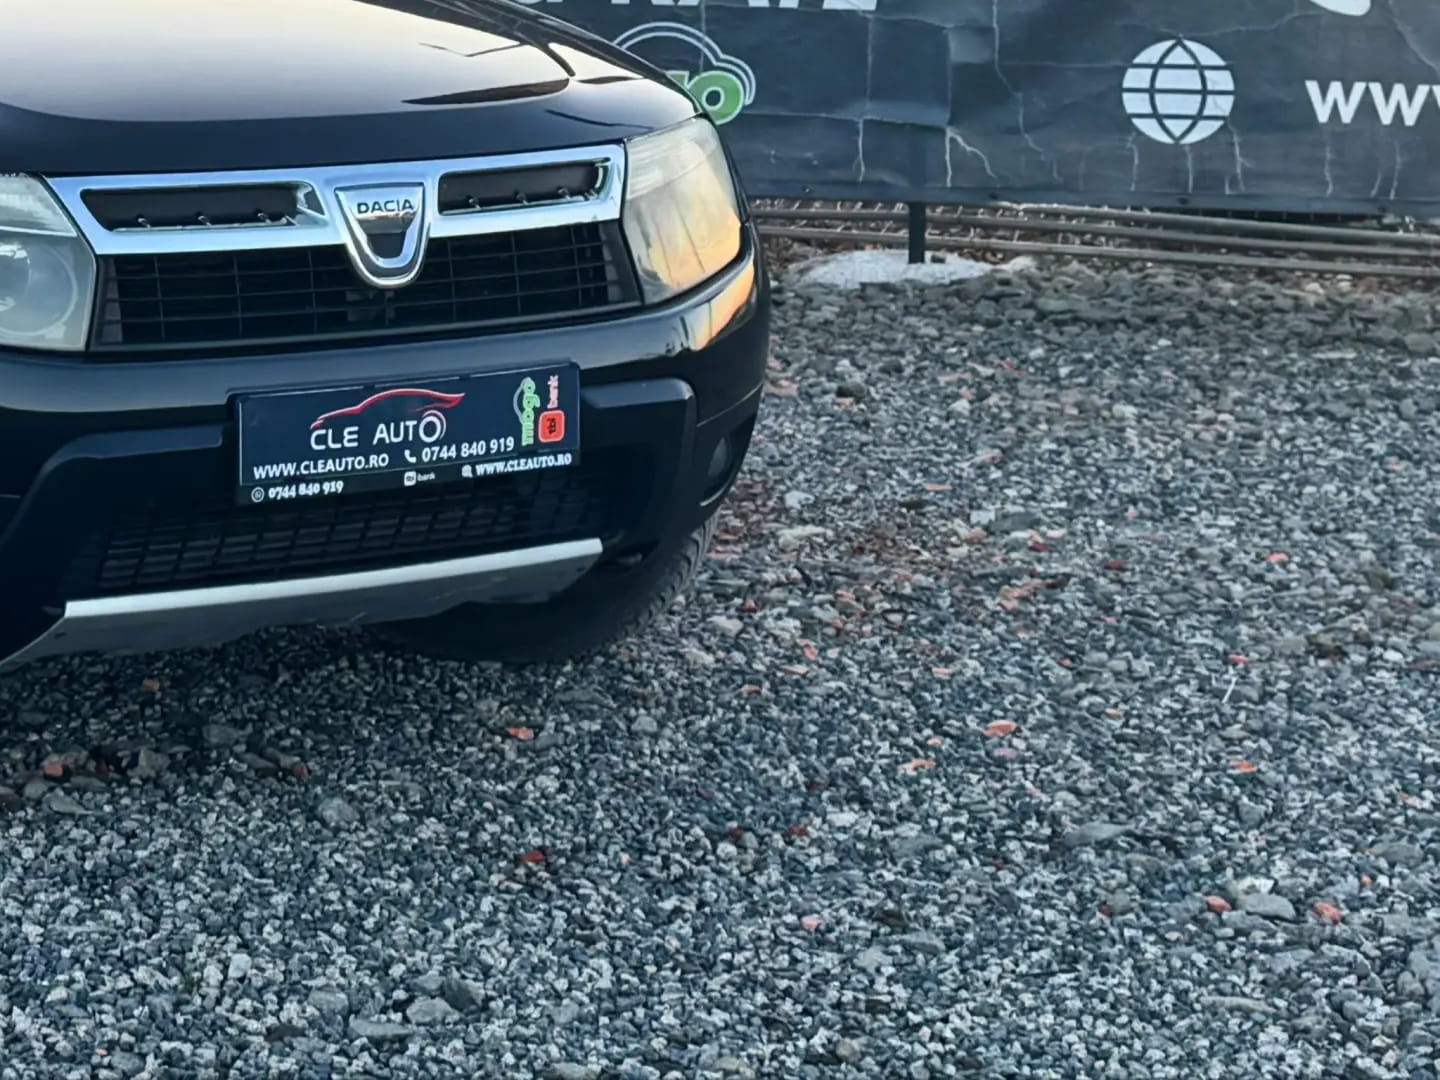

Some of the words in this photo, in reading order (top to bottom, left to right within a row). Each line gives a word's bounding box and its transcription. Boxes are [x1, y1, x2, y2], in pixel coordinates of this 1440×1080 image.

[1305, 80, 1440, 126] ww
[356, 199, 415, 214] DACIA
[310, 426, 359, 451] CLE
[372, 415, 442, 446] AUTO
[422, 444, 457, 462] 0744
[461, 440, 486, 458] 840
[490, 436, 515, 454] 919
[253, 453, 389, 480] WWW.CLEAUTO.RO
